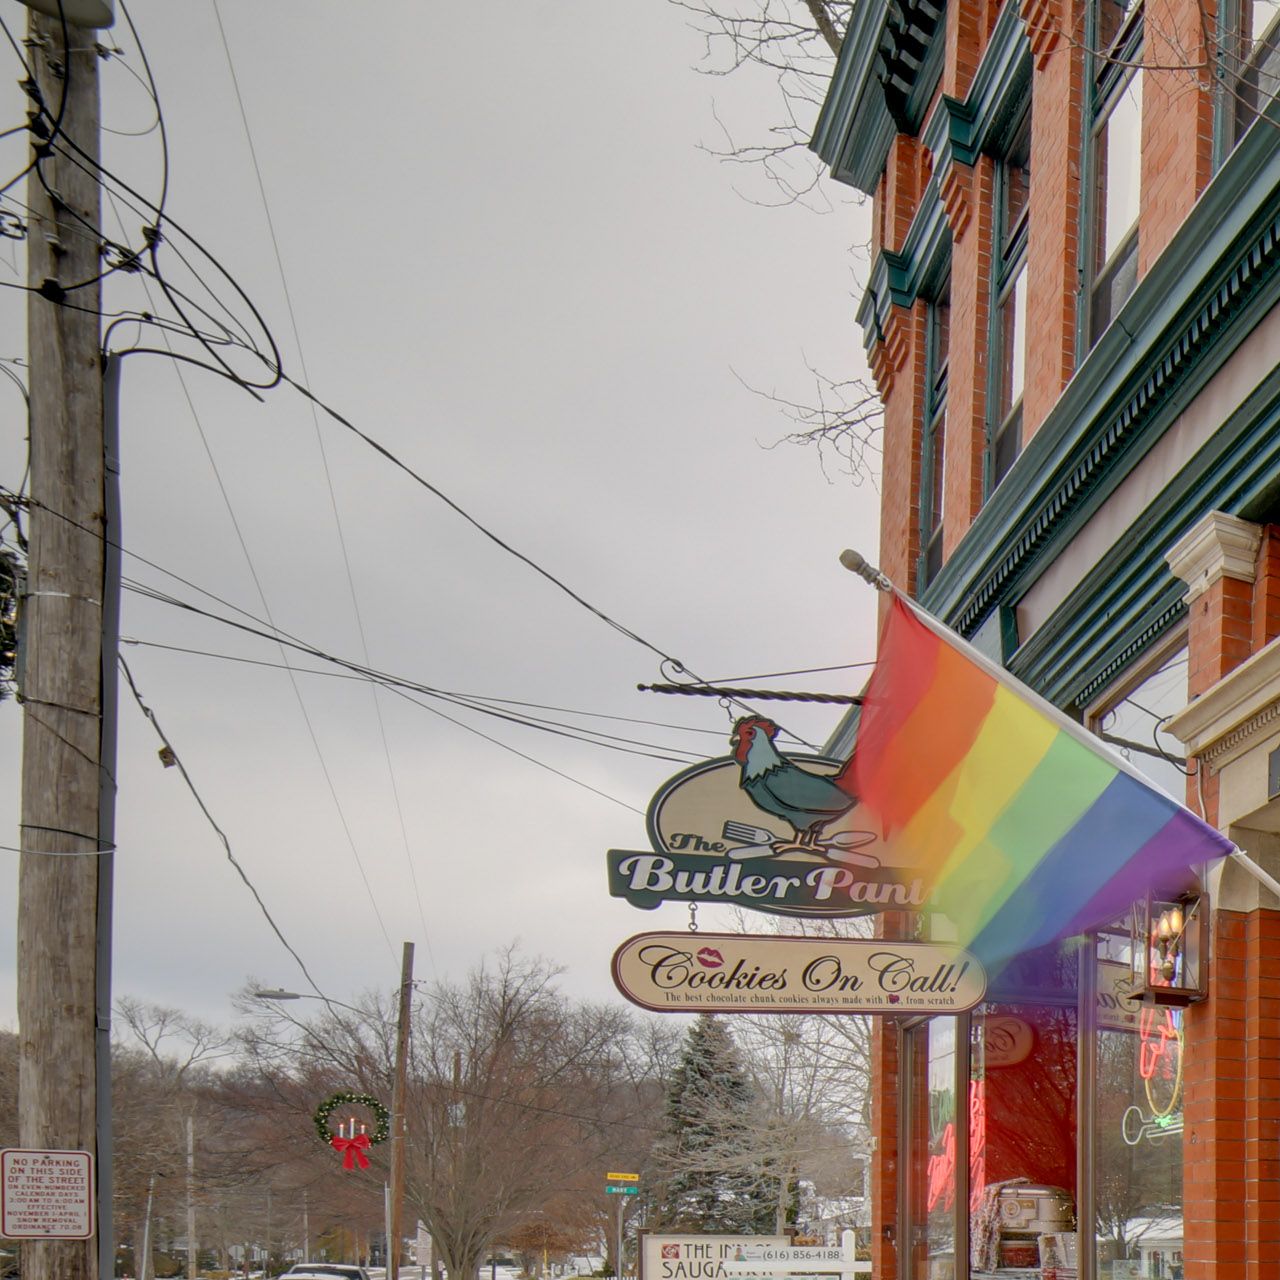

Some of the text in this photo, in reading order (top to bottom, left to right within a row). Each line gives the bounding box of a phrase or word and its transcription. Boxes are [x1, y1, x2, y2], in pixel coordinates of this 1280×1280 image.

[669, 833, 727, 854] The
[618, 854, 942, 906] Butler Pant
[638, 945, 971, 993] Cookies On Call!
[664, 992, 681, 1002] The
[684, 992, 702, 1002] best
[706, 992, 746, 1003] chocolate
[750, 993, 775, 1003] chunk
[778, 993, 809, 1004] cookies
[812, 994, 839, 1006] always
[842, 994, 862, 1004] made
[866, 995, 883, 1005] with
[906, 995, 924, 1005] from
[927, 996, 955, 1005] scratch
[13, 1158, 80, 1168] NO PARKING
[10, 1167, 85, 1176] ON THIS SIDE
[8, 1175, 85, 1185] OF THE STREET
[684, 1244, 713, 1259] THE
[763, 1250, 789, 1260] (616)
[793, 1251, 840, 1260] 856-4188
[662, 1261, 774, 1279] SAUGA
